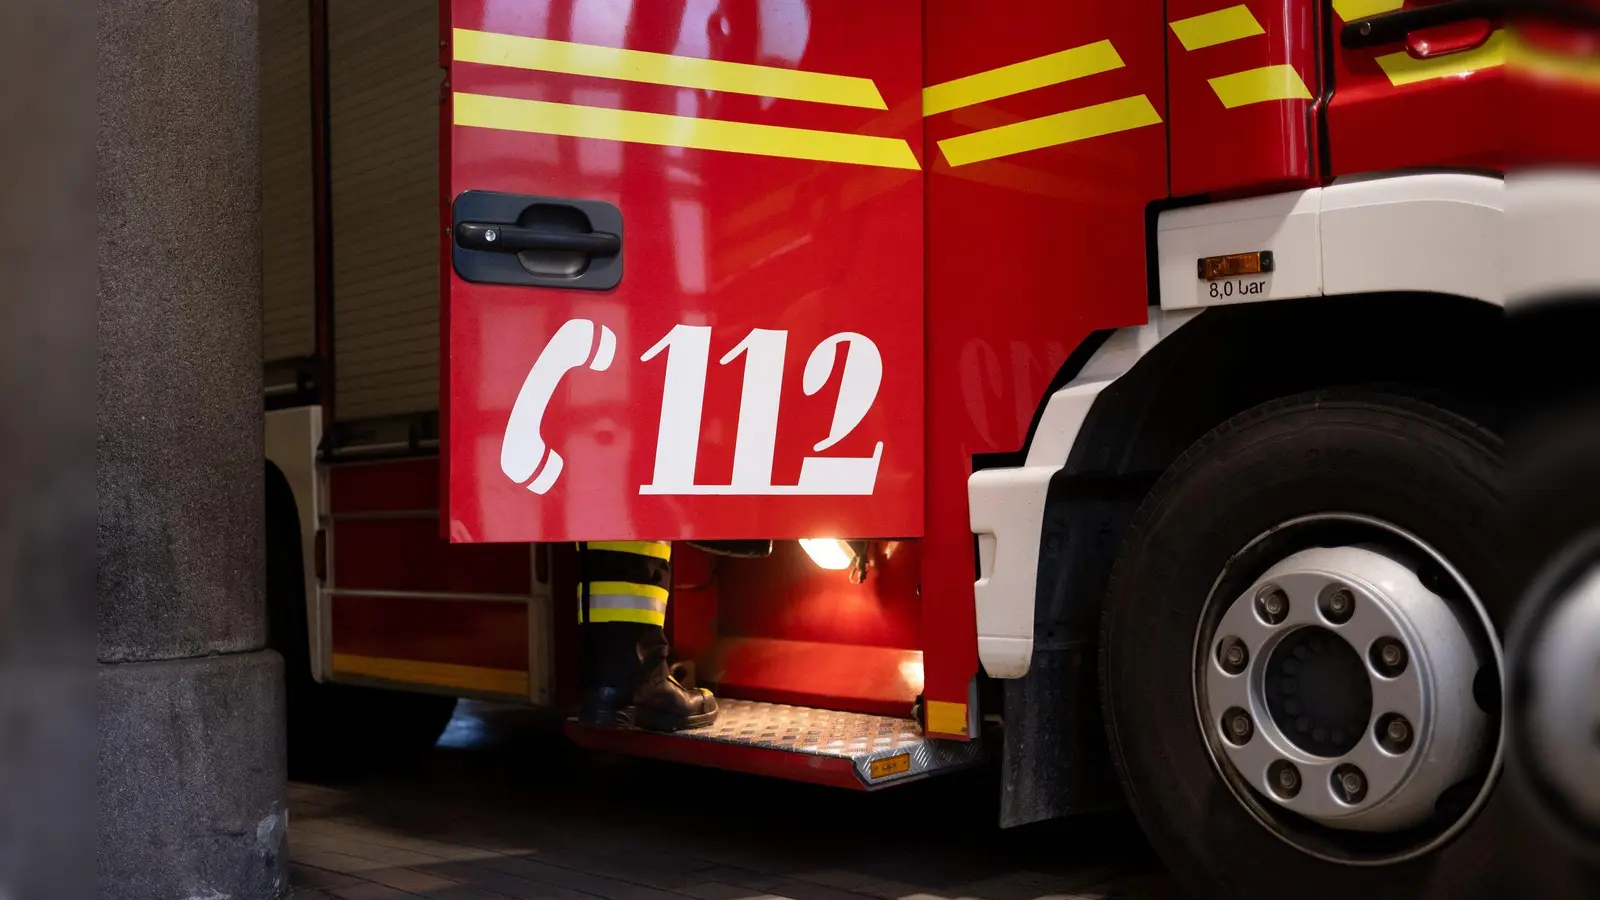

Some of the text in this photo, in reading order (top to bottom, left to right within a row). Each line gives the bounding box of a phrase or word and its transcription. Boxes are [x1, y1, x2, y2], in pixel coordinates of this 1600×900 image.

[1209, 280, 1265, 300] 8,0 bar
[639, 324, 883, 495] 112
